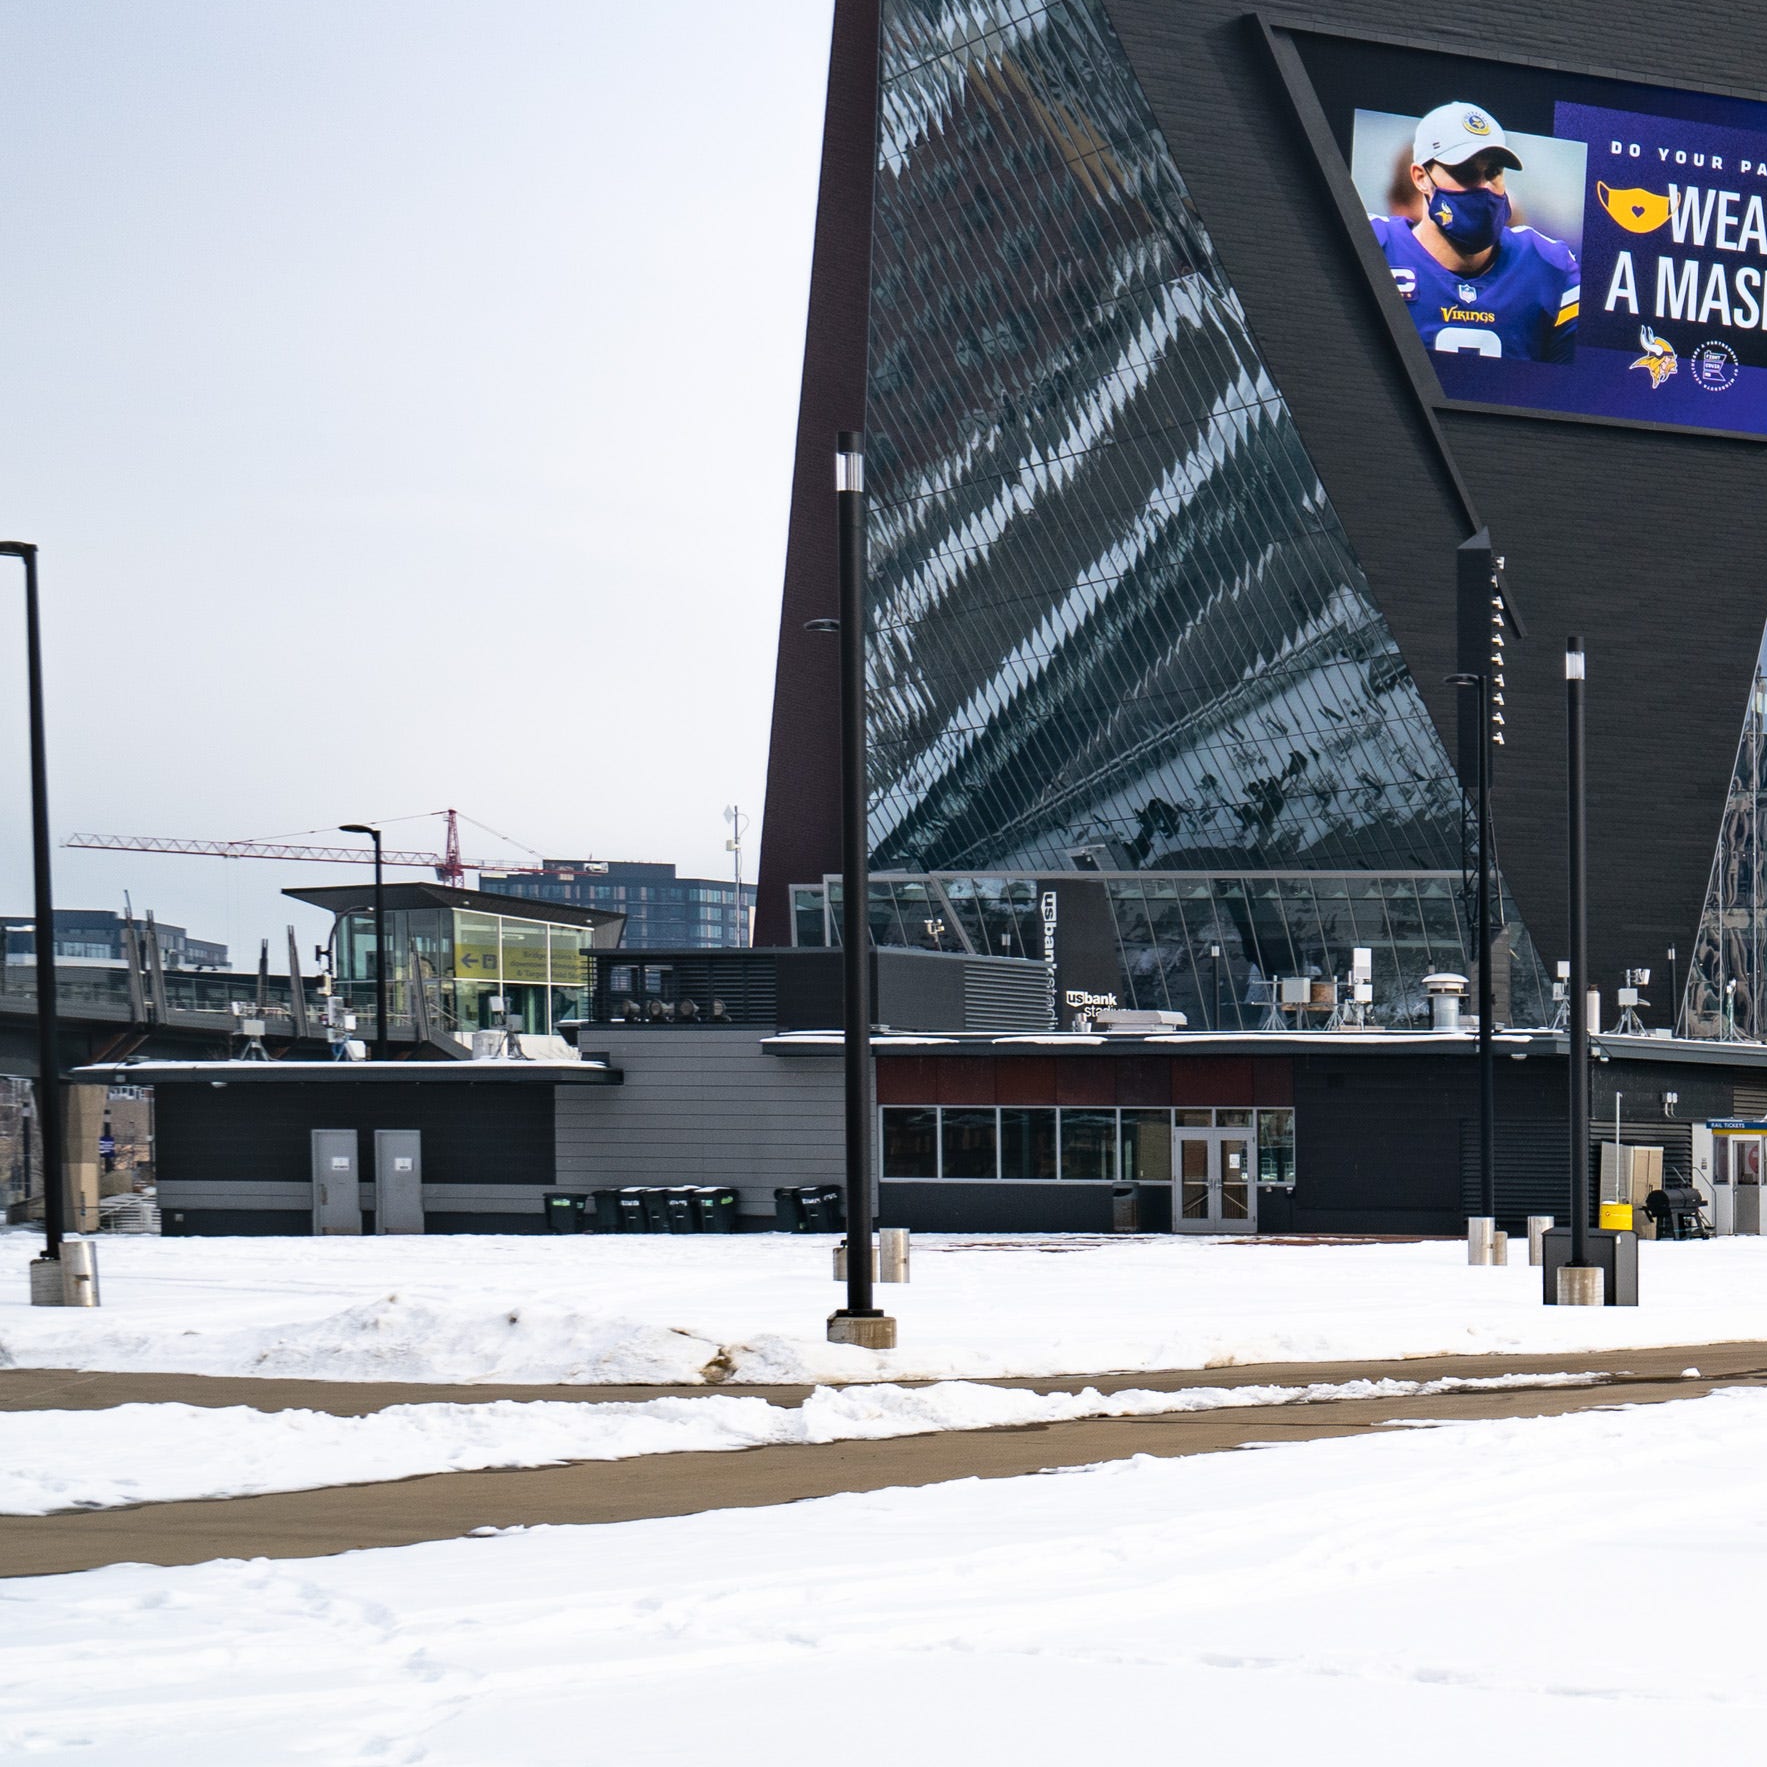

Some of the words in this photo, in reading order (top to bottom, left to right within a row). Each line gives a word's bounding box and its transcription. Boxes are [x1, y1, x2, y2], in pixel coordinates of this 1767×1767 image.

[1611, 140, 1641, 158] DO
[1658, 147, 1723, 170] YOUR
[1604, 250, 1640, 315] A
